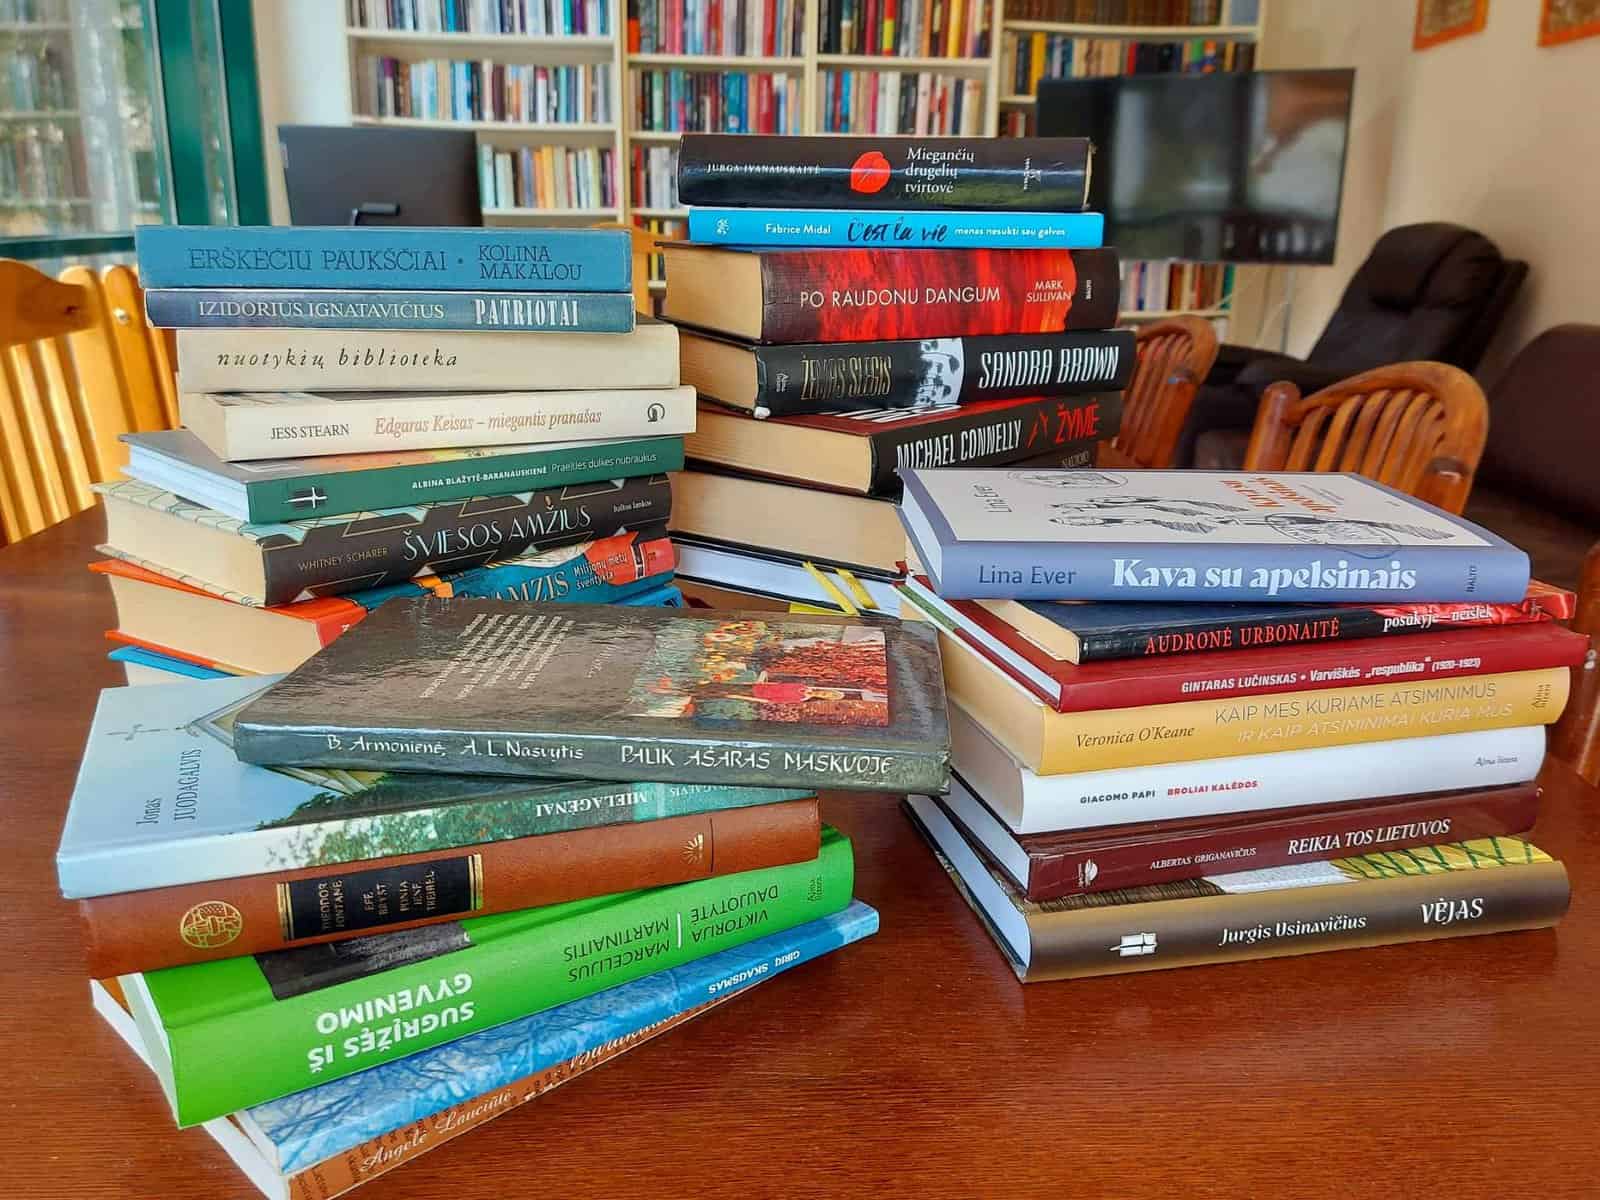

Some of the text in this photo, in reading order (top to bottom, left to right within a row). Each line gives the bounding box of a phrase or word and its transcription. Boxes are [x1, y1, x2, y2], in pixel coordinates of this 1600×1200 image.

[905, 147, 975, 163] Miegančių
[905, 163, 958, 180] drugelių
[905, 180, 954, 193] tvirtovė
[766, 224, 831, 234] Fabrice Midal
[922, 224, 948, 242] vie
[986, 226, 1019, 235] nesukti
[1039, 227, 1065, 238] galvos
[323, 248, 447, 271] PAUKŠČIAI
[479, 245, 552, 263] KOLINA
[480, 263, 582, 280] MAKALOU
[799, 285, 1000, 308] PO RAUDONU DANGUM
[1026, 291, 1072, 304] SULLIVAN
[1034, 280, 1064, 291] MARK
[199, 299, 579, 326] IZIDORIUS IGNATAVIČIUS PATRIOTAI
[217, 348, 457, 369] nuotykių biblioteka
[978, 346, 1119, 390] SANDRA BROWN
[271, 424, 350, 440] JESS STEARN
[374, 416, 428, 438] Edgaras
[432, 415, 474, 432] Keisas
[488, 411, 546, 432] miegantis
[549, 409, 601, 430] pranašas
[1055, 402, 1099, 444] ŽYMĖ
[897, 433, 955, 468] MICHAEL
[960, 419, 1022, 461] CONNELLY
[412, 478, 444, 489] ALBINA
[403, 504, 592, 562] ŠVIESOS AMŽIUS
[298, 556, 342, 571] WHITNEY
[978, 565, 1077, 585] Lina Ever
[1112, 559, 1417, 595] Kava su apelsinais
[1144, 626, 1233, 655] AUDRONĖ
[1240, 617, 1340, 646] URBONAITĖ
[1182, 678, 1235, 693] GINTARAS
[1238, 672, 1297, 689] LUČINSKAS
[1310, 667, 1361, 682] Varviškės
[1216, 682, 1497, 724] KAIP MES KURIAME ATSIMINIMUS
[1076, 725, 1195, 748] Veronica O'Keane
[1238, 731, 1256, 743] IR
[1258, 724, 1302, 741] KAIP
[1306, 714, 1415, 737] ATSIMINIMAI
[1420, 710, 1472, 726] KURIA
[327, 734, 343, 751] B.
[460, 737, 482, 756] A.
[621, 745, 894, 775] PALIK AŠARAS MASKVOJE
[174, 749, 202, 821] JUODAGALVIS
[1080, 790, 1156, 804] GIACOMO PAPI
[1167, 780, 1258, 796] BROLIAI KALĖDOS
[136, 798, 161, 824] Jonas
[1287, 819, 1451, 857] REIKIA TOS LIETUVOS
[1150, 847, 1257, 870] ALBERTAS GRIGANAVIČIUS
[690, 884, 779, 924] DAUJOTYTĖ
[1421, 897, 1484, 926] VĖJAS
[692, 909, 769, 943] VIKTORIJA
[1218, 915, 1367, 946] Jurgis Usinavičius
[563, 917, 670, 962] MARTINAITIS
[568, 940, 670, 982] MARCELIJUS
[708, 963, 769, 994] SKAUSMAS
[316, 973, 473, 1034] GYVENIMO
[307, 1002, 475, 1073] SUGRĮŽĘS IŠ
[359, 1128, 428, 1172] Angelė
